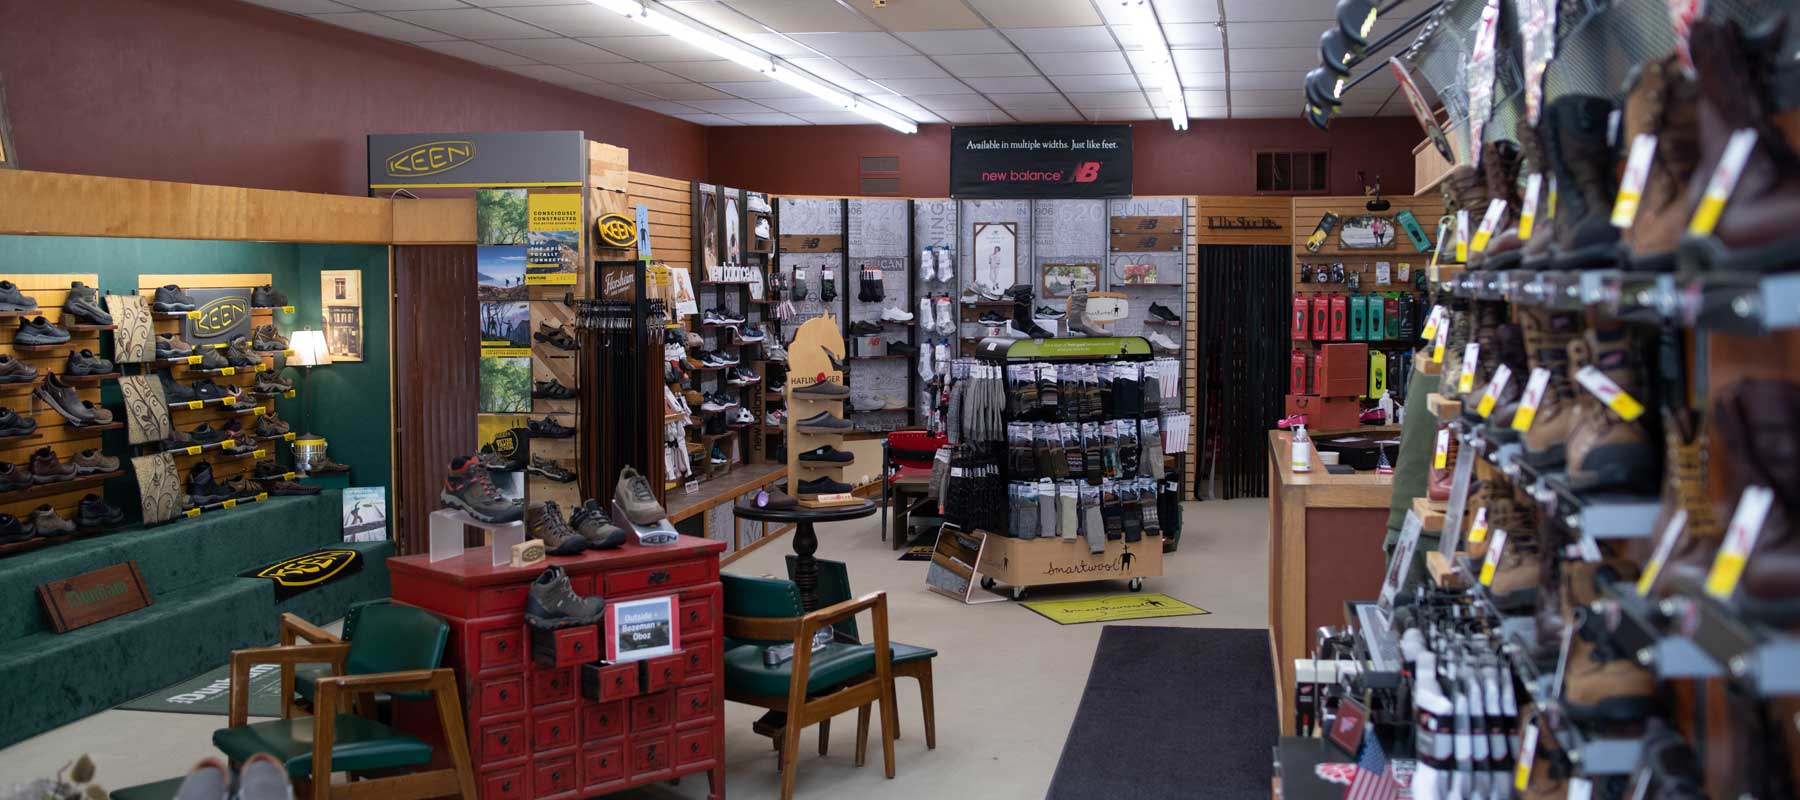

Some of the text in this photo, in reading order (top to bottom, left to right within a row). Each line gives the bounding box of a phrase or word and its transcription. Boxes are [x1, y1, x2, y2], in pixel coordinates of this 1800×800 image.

[966, 139, 1119, 151] Available in multiple widths. Just like feet.
[390, 145, 470, 172] KEEN
[982, 171, 1007, 181] new
[1010, 169, 1062, 181] balance
[602, 220, 635, 240] KEEN
[604, 270, 635, 296] Florsheim
[195, 303, 246, 330] KEEN
[641, 535, 678, 545] KEEN
[624, 611, 652, 623] Outside
[622, 621, 656, 633] Bozeman
[632, 632, 651, 641] Oboz
